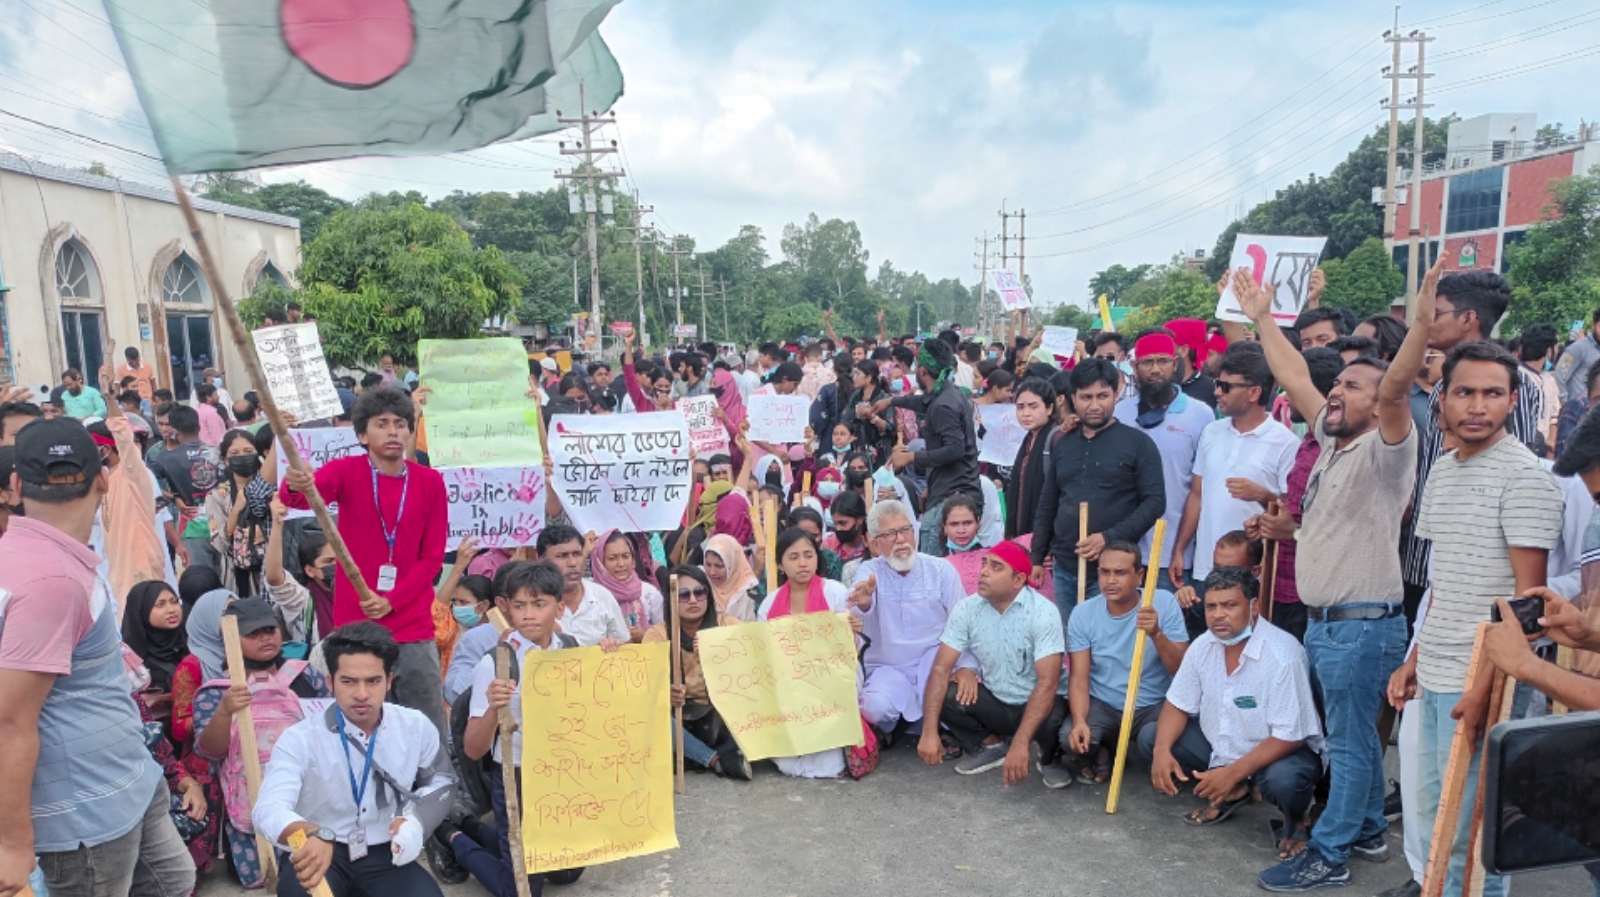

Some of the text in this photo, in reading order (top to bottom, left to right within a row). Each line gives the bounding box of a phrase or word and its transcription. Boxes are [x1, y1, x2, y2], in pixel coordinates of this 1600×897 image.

[560, 434, 627, 459] লাশের
[632, 431, 682, 454] ভেতর
[559, 456, 690, 483] জীবন দে নইলে
[447, 482, 522, 504] Justice
[663, 484, 688, 502] দে
[471, 504, 488, 519] Is
[531, 648, 652, 708] তোর কোটা
[716, 664, 778, 703] ২০২৪
